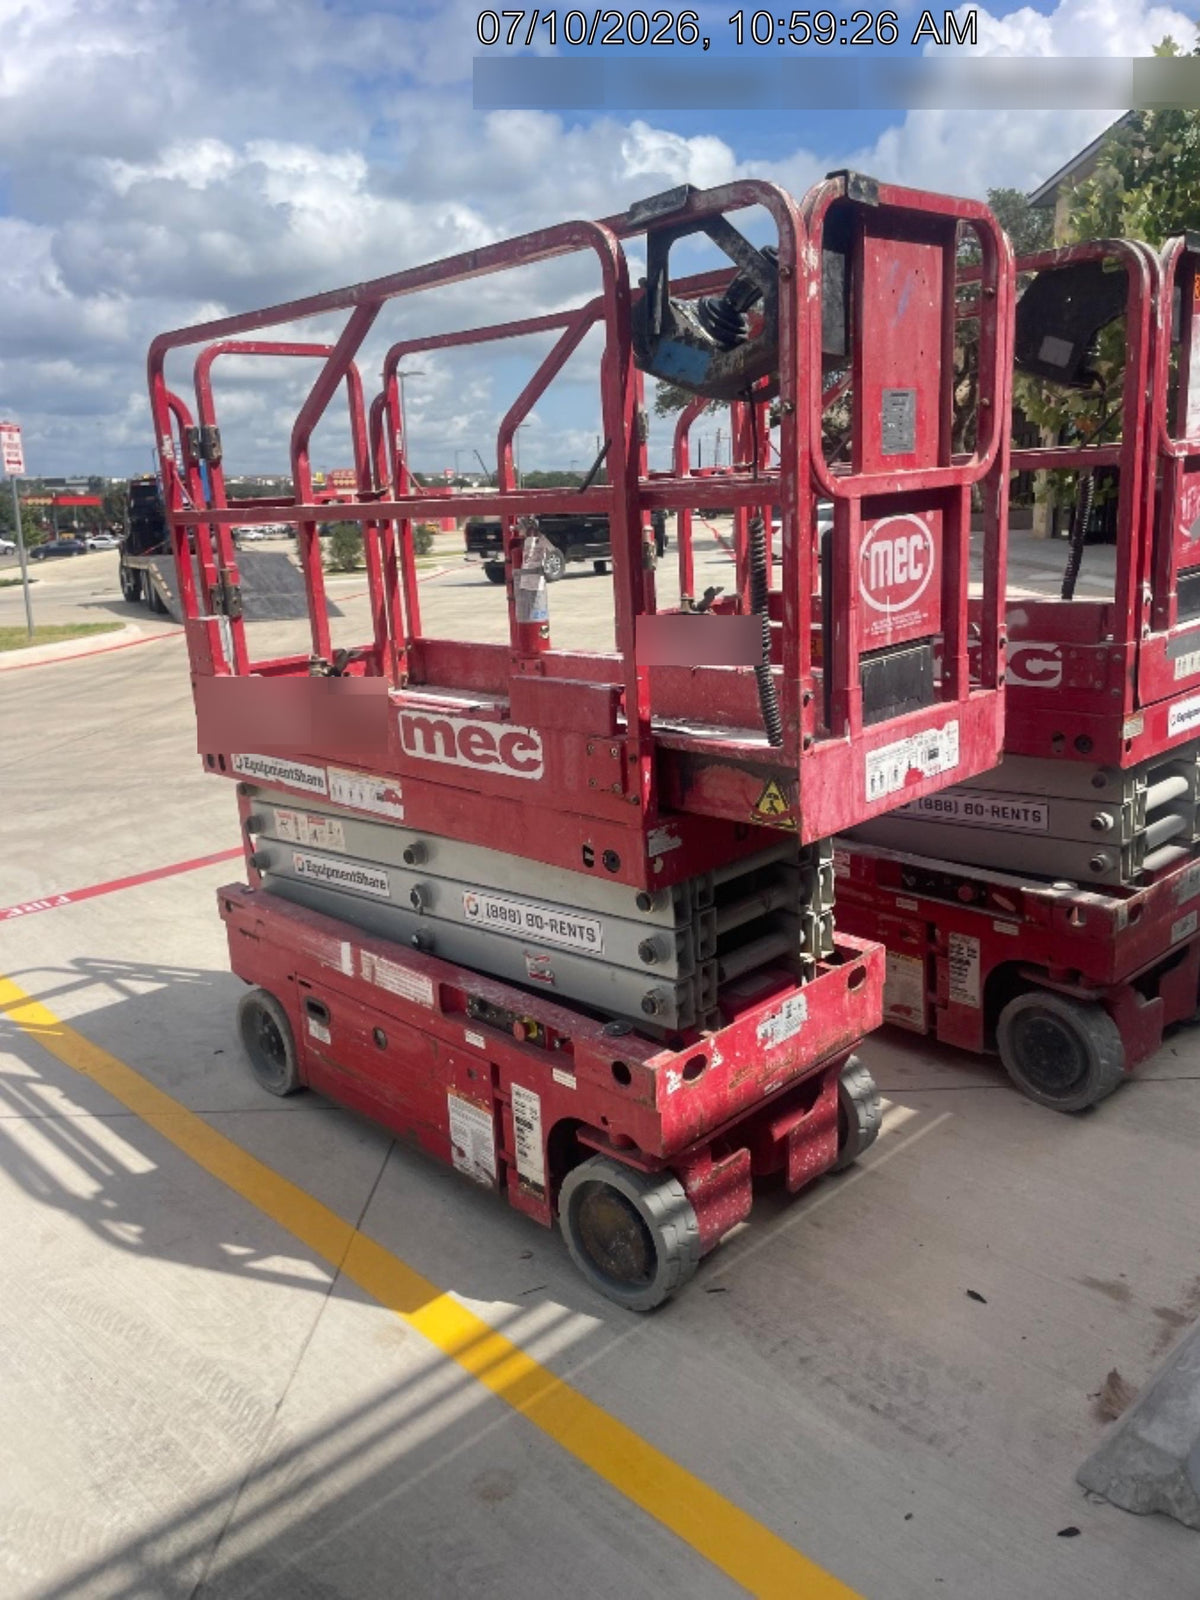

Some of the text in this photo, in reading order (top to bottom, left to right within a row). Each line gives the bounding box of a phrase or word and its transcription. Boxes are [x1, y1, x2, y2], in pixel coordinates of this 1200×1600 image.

[870, 533, 924, 591] mec
[401, 714, 542, 772] mec
[919, 798, 1042, 823] (888) 80-RENTS
[305, 860, 386, 890] EquipmentShare
[485, 902, 596, 943] (888) 80-RENTS
